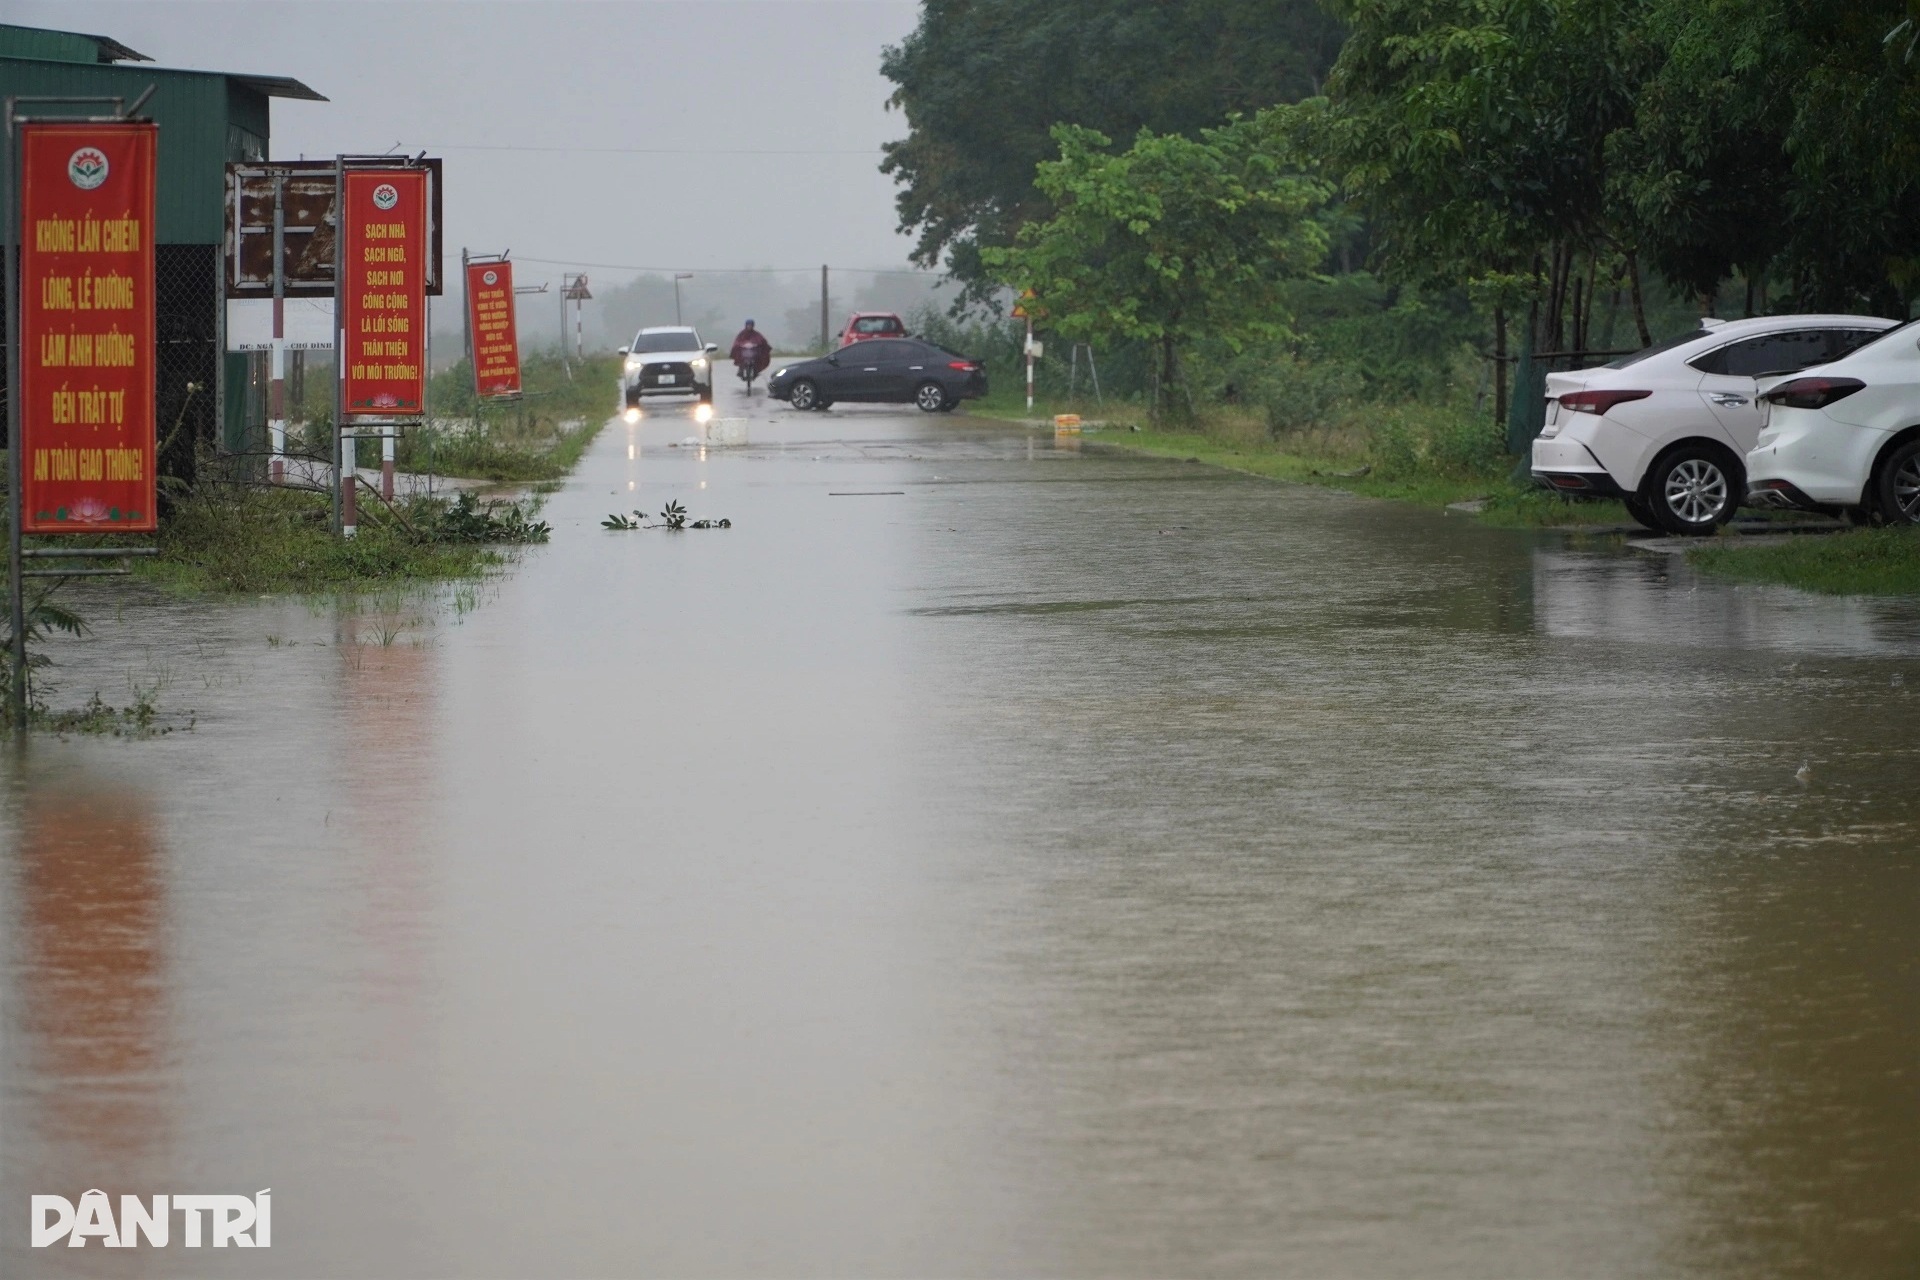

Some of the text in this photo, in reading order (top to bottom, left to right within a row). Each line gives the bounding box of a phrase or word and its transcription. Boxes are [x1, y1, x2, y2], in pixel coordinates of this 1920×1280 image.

[36, 208, 140, 252] KHÔNG LẤN CHIẾM
[365, 221, 406, 241] SẠCH NHÀ
[364, 247, 386, 265] SẠCH
[367, 270, 404, 289] SẠCH NƠI
[42, 268, 75, 313] LÒNG,
[94, 268, 134, 310] ĐƯỜNG
[362, 291, 408, 312] CÔNG CỘNG
[361, 313, 409, 332] LÀ LỐI SỐNG
[41, 323, 135, 367] LÀM ẢNH HƯỞNG
[362, 338, 408, 360] THÂN THIỆN
[352, 361, 418, 380] VỚI MÔI TRƯỜNG!
[53, 381, 124, 431] ĐẾN TRẬT TỰ
[34, 441, 143, 481] AN TOÀN GIAO THÔNG!
